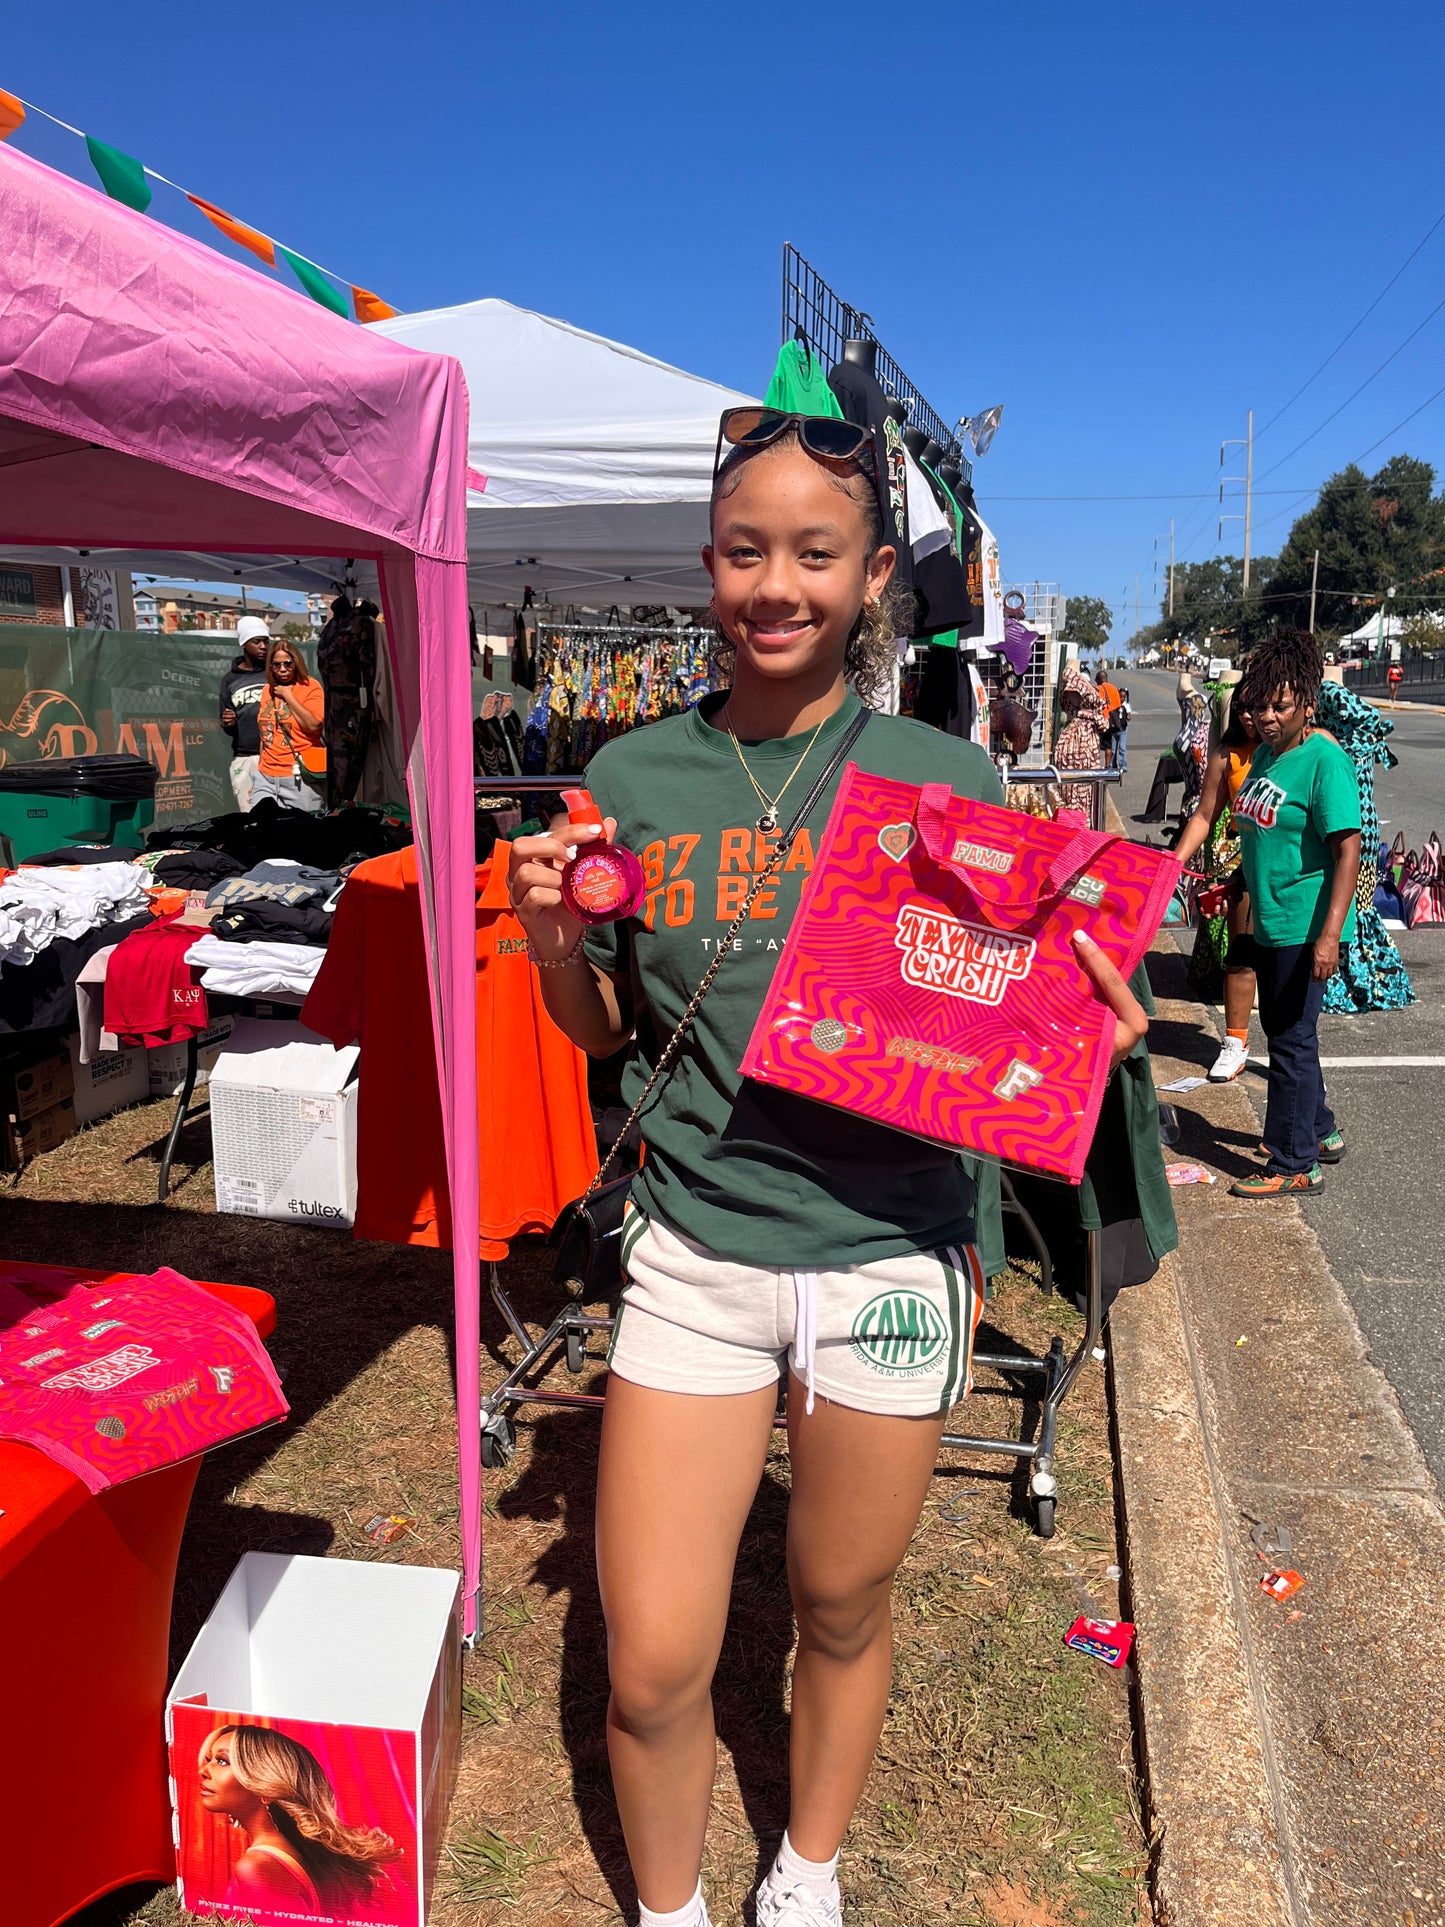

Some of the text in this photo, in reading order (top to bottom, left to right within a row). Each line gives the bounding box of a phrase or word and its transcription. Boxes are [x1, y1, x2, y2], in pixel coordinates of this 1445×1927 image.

[162, 669, 201, 687] DEERE
[186, 735, 205, 745] LLC
[1234, 778, 1285, 828] AMU
[637, 828, 825, 891] 87 REA
[954, 842, 1013, 872] FAMU
[715, 876, 781, 922] BE
[497, 938, 527, 955] FAM
[901, 911, 1030, 973] TEXTURE
[906, 949, 1003, 999] CRUSH
[92, 1060, 125, 1079] RESPECT
[998, 1062, 1040, 1098] F
[299, 1200, 343, 1219] tultex
[859, 1296, 941, 1364] FAMU
[49, 1346, 149, 1387] TEXTURE
[84, 1358, 157, 1390] CRUSH
[871, 1364, 895, 1378] A&M
[899, 1345, 951, 1378] UNIVERSITY
[215, 1368, 232, 1391] F
[233, 1905, 262, 1914] FREE
[273, 1911, 334, 1924] HYDRATED
